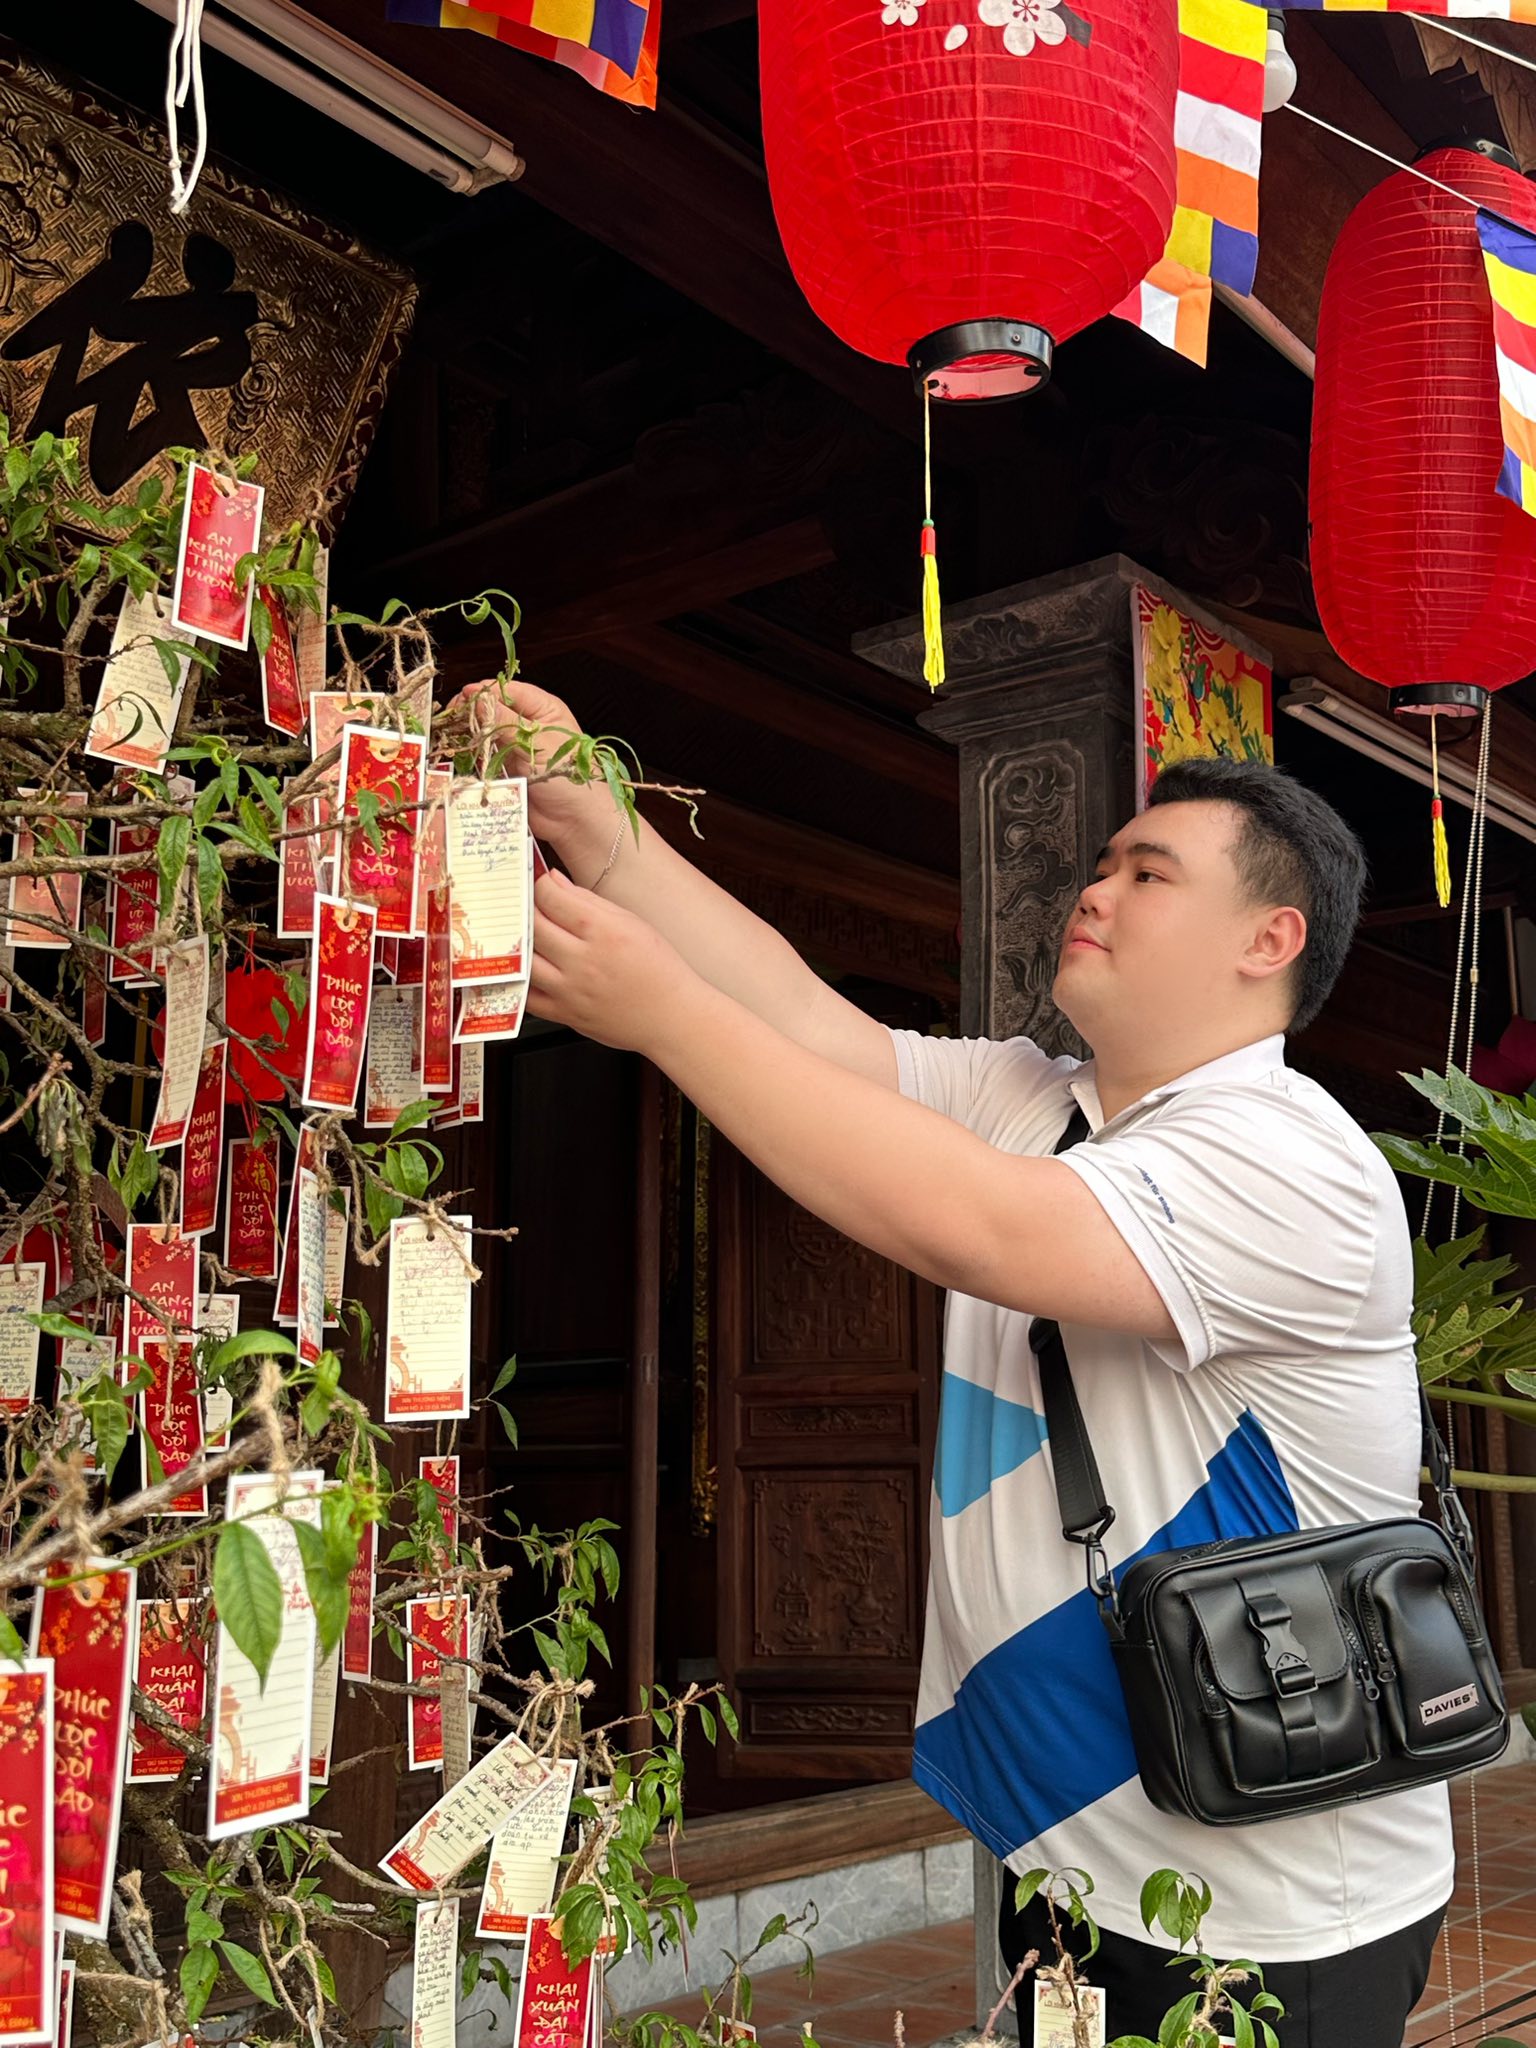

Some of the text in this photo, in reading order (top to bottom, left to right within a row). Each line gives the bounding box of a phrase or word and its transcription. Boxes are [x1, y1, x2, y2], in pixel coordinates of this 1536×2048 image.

[206, 531, 233, 547] AN
[188, 537, 238, 562] KHAN
[357, 857, 399, 877] DÀO
[322, 974, 363, 996] PHÚC
[331, 995, 356, 1014] LỘC
[330, 1011, 354, 1030] DỒI
[326, 1027, 354, 1048] DÀO
[191, 1110, 216, 1129] KHAI
[189, 1126, 217, 1147] XUÂN
[192, 1159, 214, 1179] CÁT
[242, 1202, 264, 1215] LỘC
[240, 1225, 265, 1239] DÀO
[149, 1281, 175, 1293] AN
[132, 1294, 192, 1307] ANG
[161, 1417, 188, 1434] LỘC
[161, 1431, 187, 1447] DỒI
[158, 1446, 191, 1463] DÀO
[150, 1664, 194, 1679] KHAI
[145, 1678, 197, 1696] XUÂN
[1424, 1693, 1471, 1718] DAVIES
[55, 1718, 100, 1750] LỘC
[55, 1778, 95, 1813] ÀO
[536, 1982, 578, 1997] KHAI
[530, 1996, 580, 2014] XUÂN
[534, 2028, 573, 2047] CÁT
